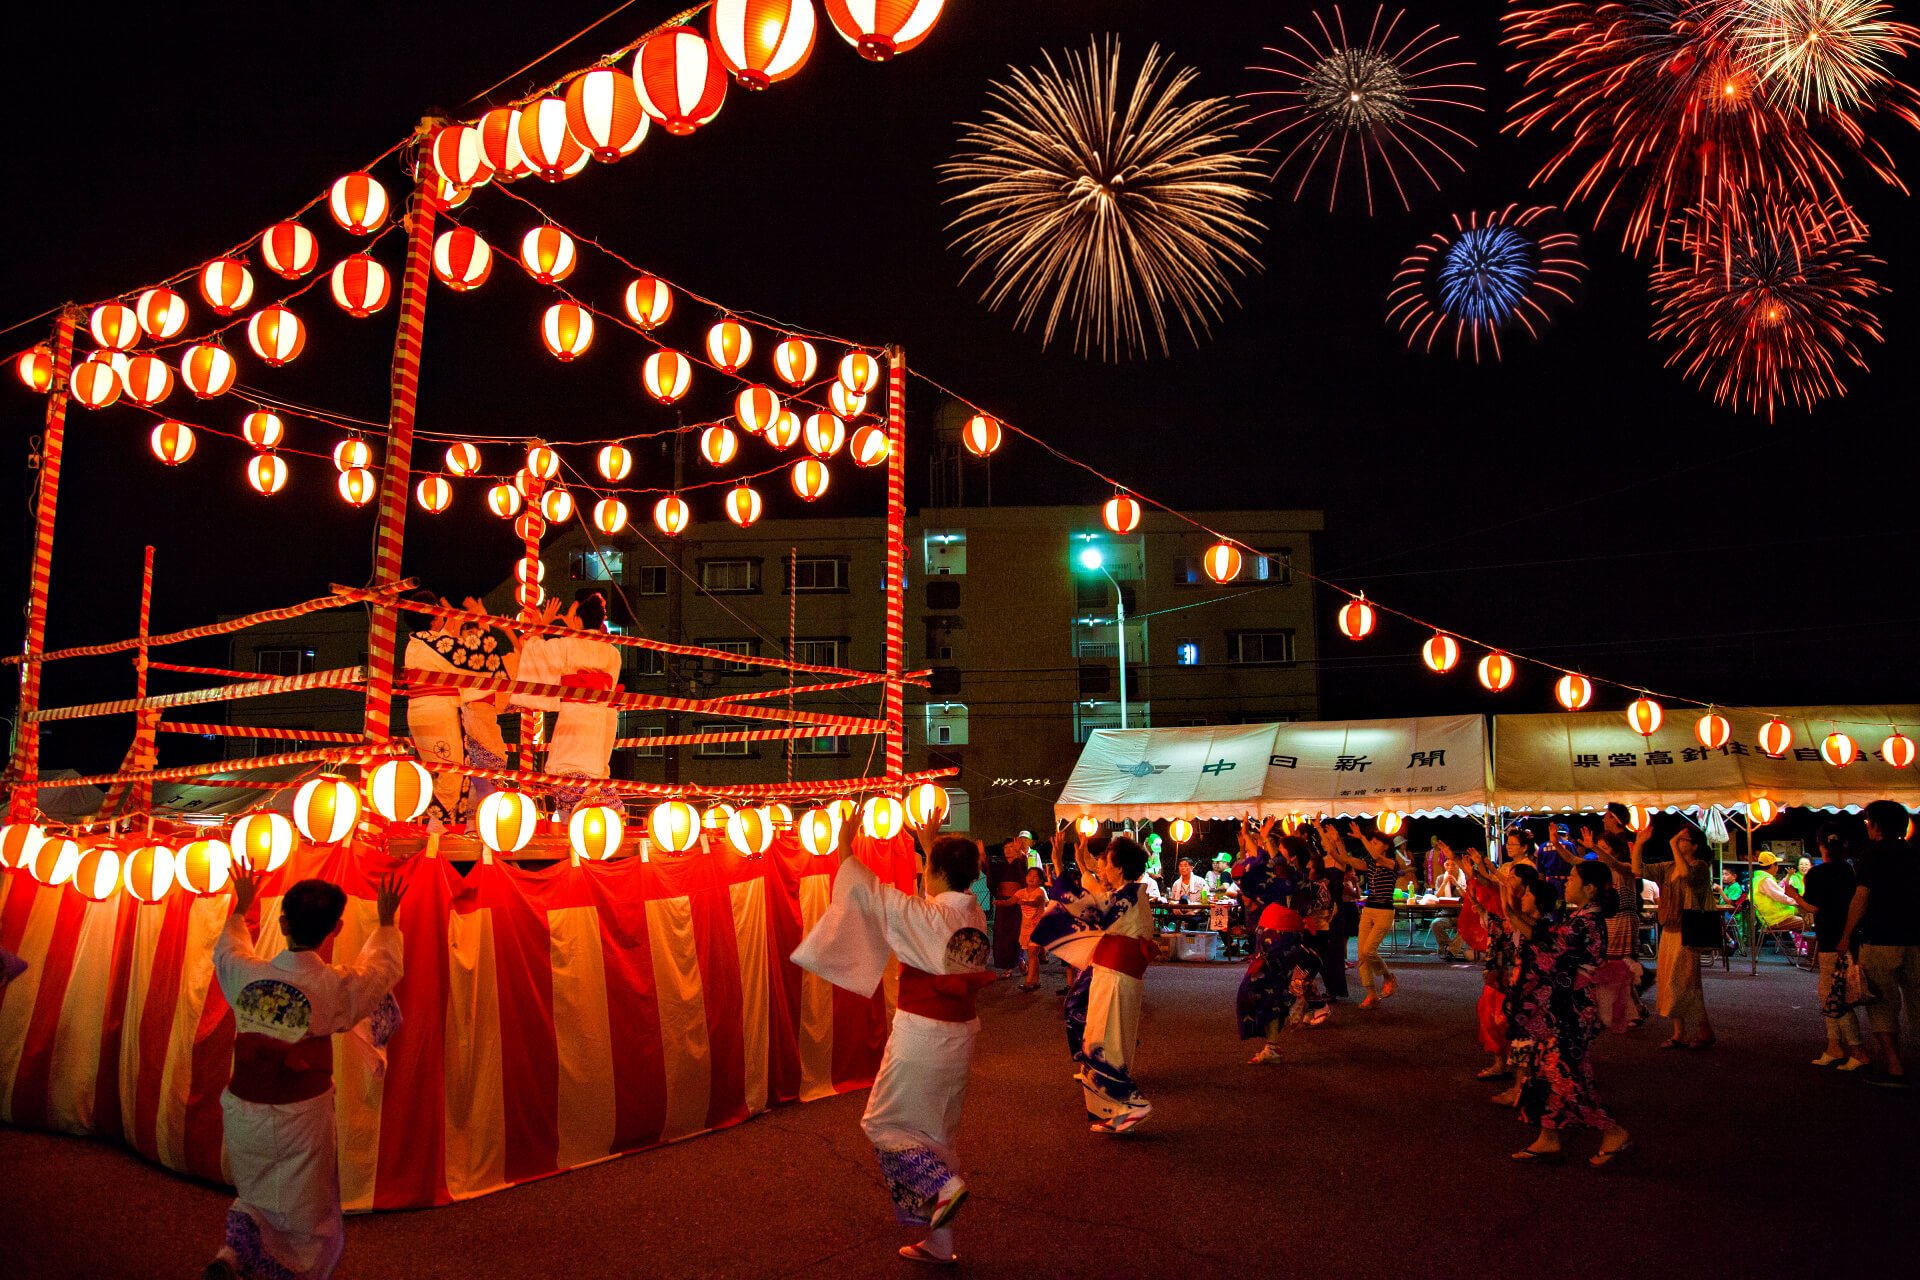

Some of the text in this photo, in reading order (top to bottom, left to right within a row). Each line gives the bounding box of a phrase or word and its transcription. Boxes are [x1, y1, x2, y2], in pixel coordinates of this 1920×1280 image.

[1202, 749, 1446, 777] 中日新聞
[1574, 741, 1884, 769] 県営高針住宅自
